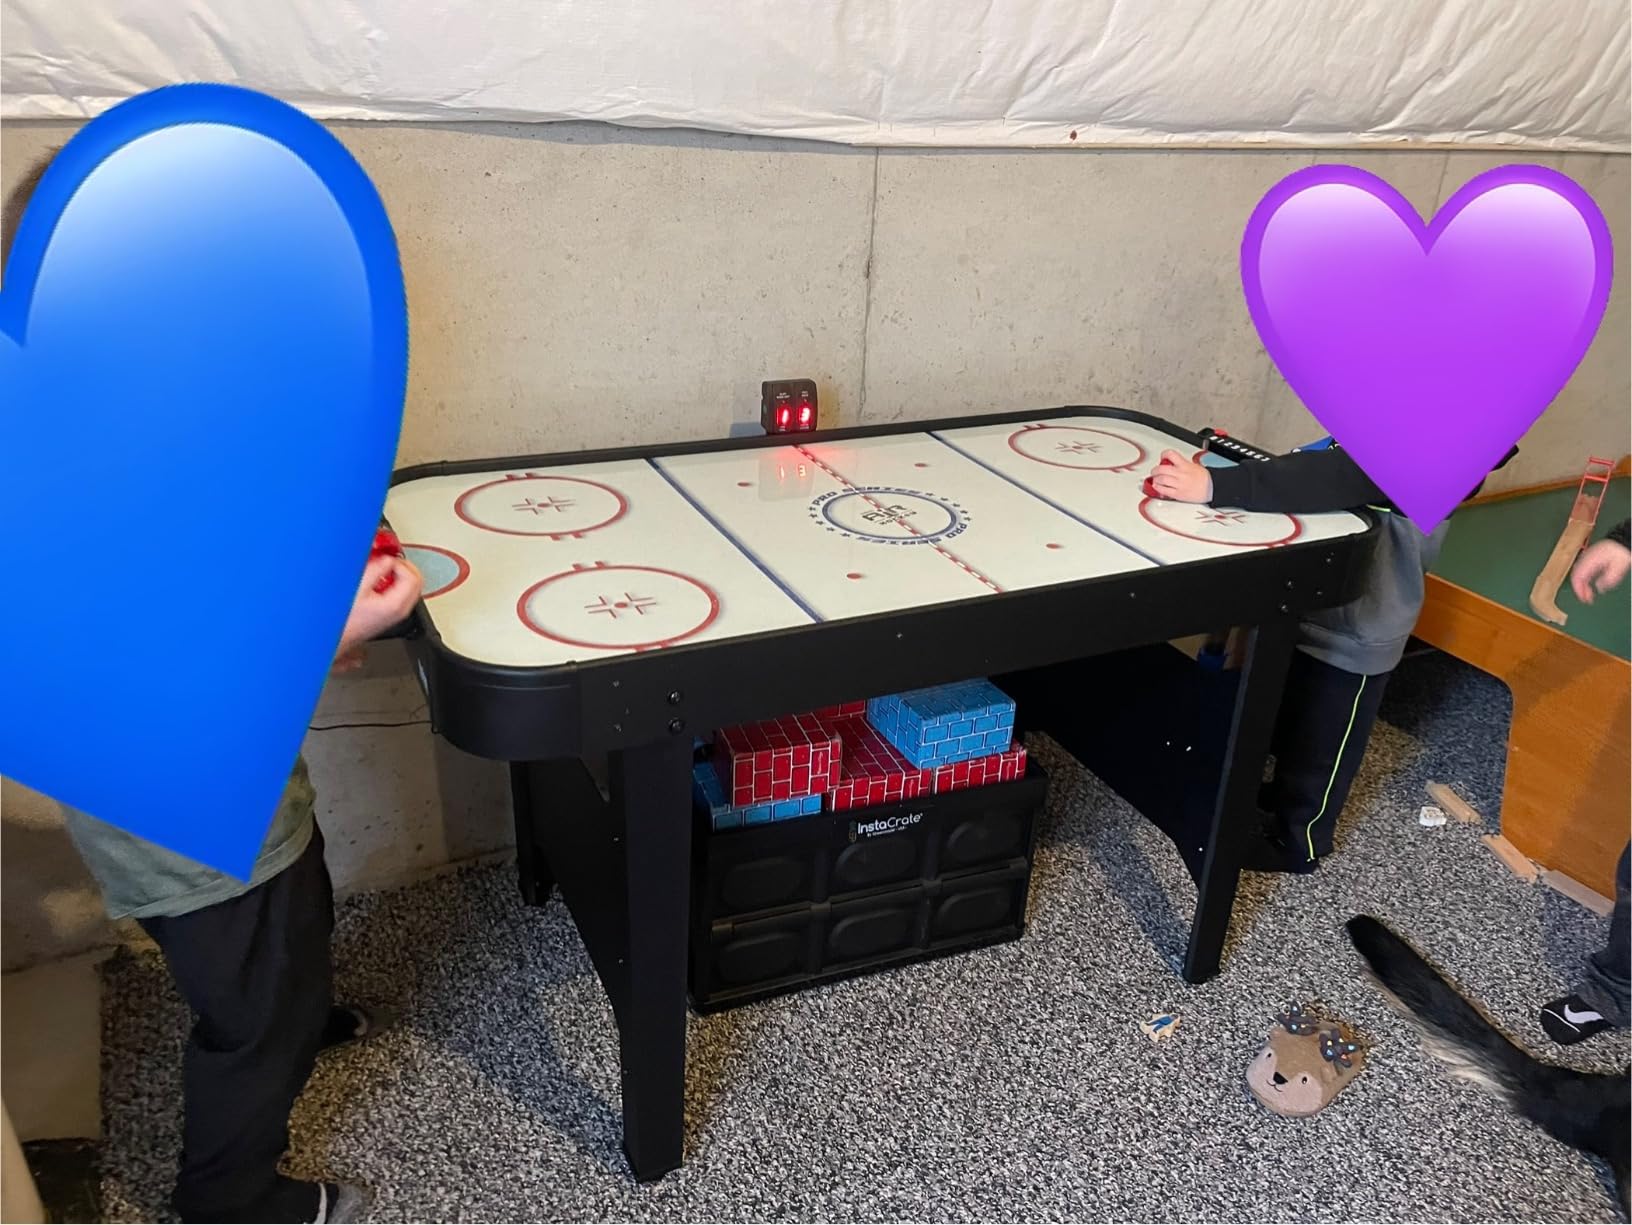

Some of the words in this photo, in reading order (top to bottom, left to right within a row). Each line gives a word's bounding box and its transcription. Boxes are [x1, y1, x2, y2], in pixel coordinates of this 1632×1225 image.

[812, 491, 838, 506] PRO
[842, 486, 922, 494] SERIES
[945, 522, 968, 538] PRO
